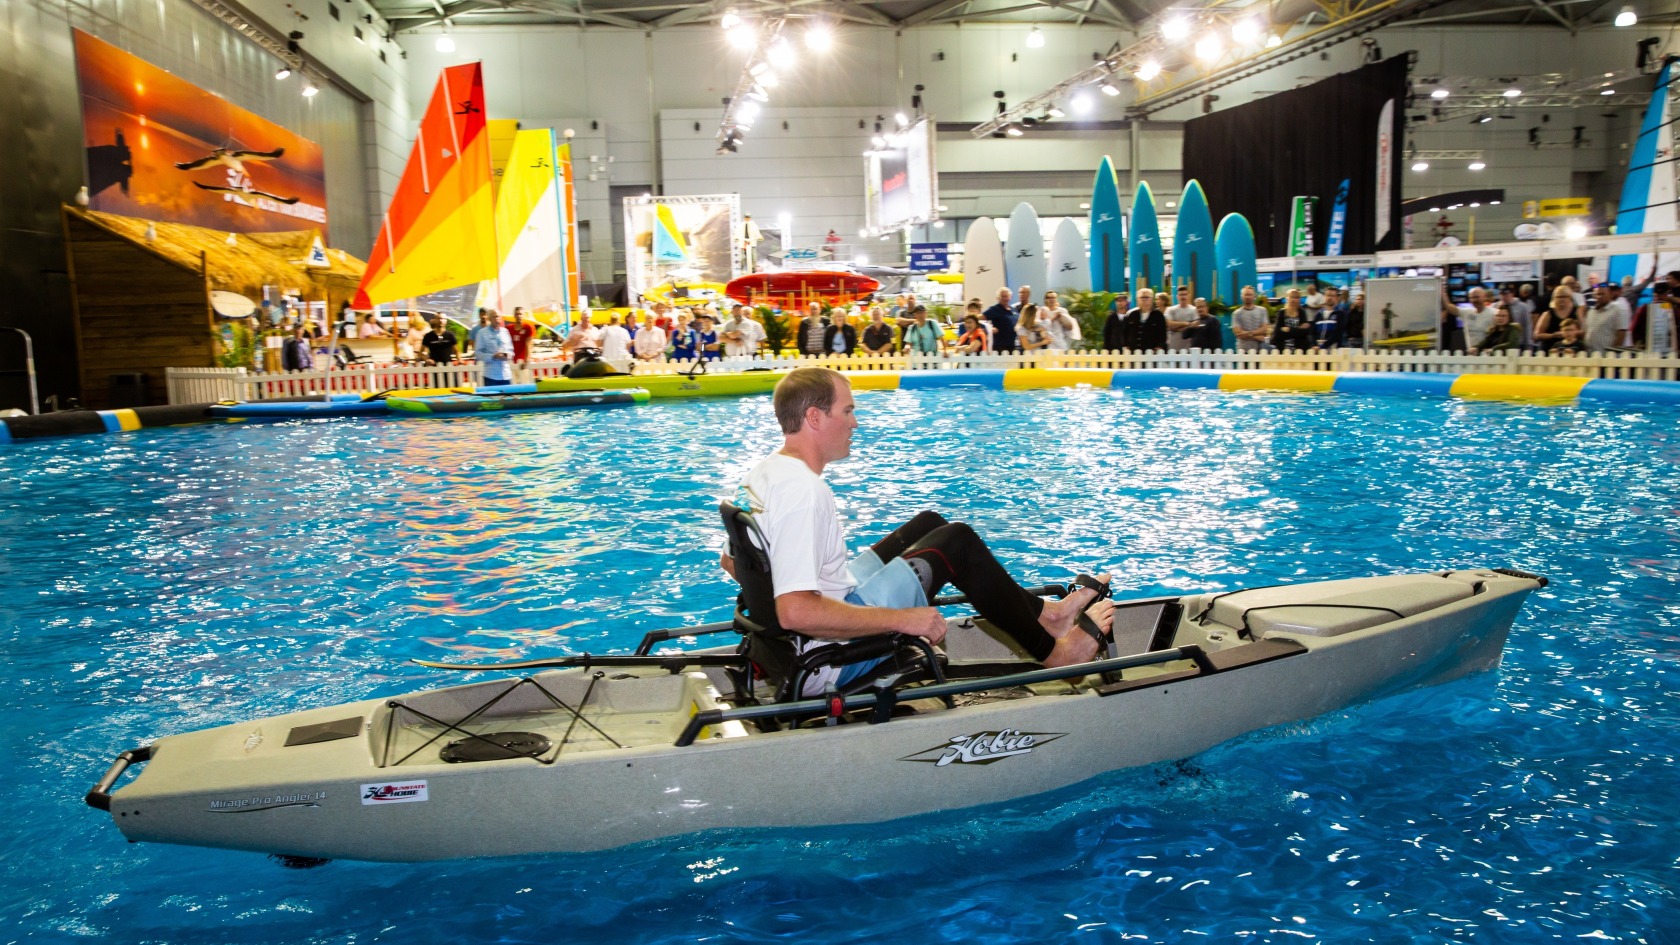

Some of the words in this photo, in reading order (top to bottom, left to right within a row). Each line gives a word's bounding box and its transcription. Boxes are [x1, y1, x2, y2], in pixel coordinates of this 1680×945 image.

[934, 727, 1035, 767] Hobie
[210, 799, 249, 809] Mirage
[252, 797, 272, 805] Pro
[275, 793, 312, 804] Angler
[315, 791, 327, 800] 14
